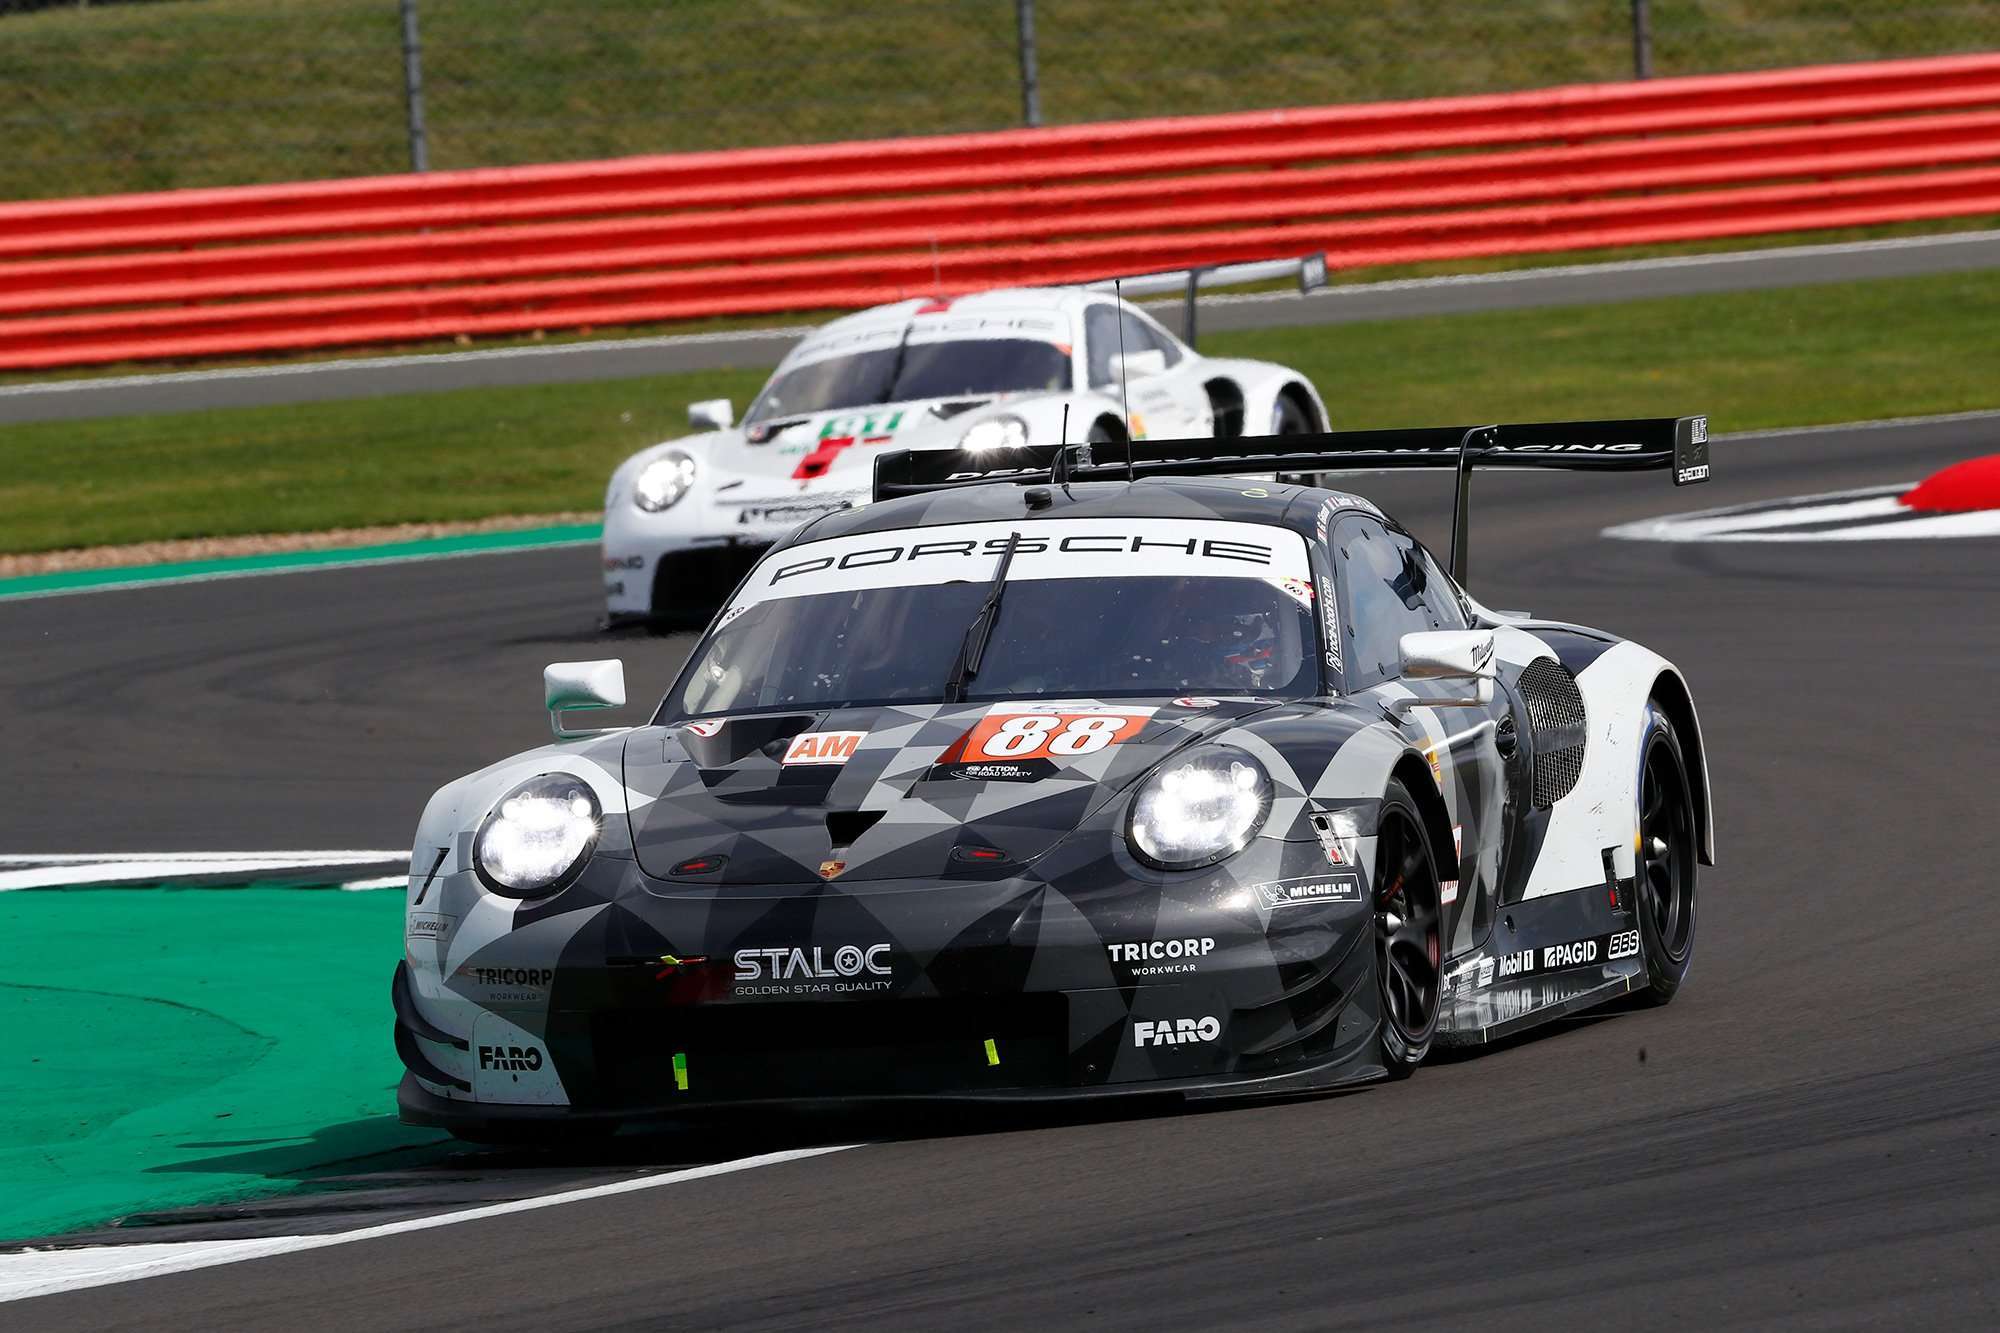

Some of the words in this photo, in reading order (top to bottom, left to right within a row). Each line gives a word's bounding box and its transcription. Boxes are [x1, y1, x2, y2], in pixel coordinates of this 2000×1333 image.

[769, 536, 1272, 588] PORSCHE
[789, 736, 861, 758] AM
[982, 716, 1129, 757] 88
[1290, 883, 1352, 898] MICHELIN
[1108, 938, 1215, 962] TRICORP
[1556, 941, 1597, 968] PAGID
[1609, 930, 1640, 959] BBS
[734, 944, 892, 981] STALOC
[1131, 964, 1197, 976] WORKWEAR
[1499, 951, 1522, 977] Mobil
[1523, 949, 1534, 971] 1
[475, 968, 553, 986] TRICORP
[735, 985, 790, 996] GOLDEN
[794, 983, 831, 993] STAR
[834, 981, 892, 993] QUALITY
[489, 992, 537, 1001] WORKWEAR
[1134, 1016, 1220, 1047] FARO
[479, 1045, 543, 1072] FARO
